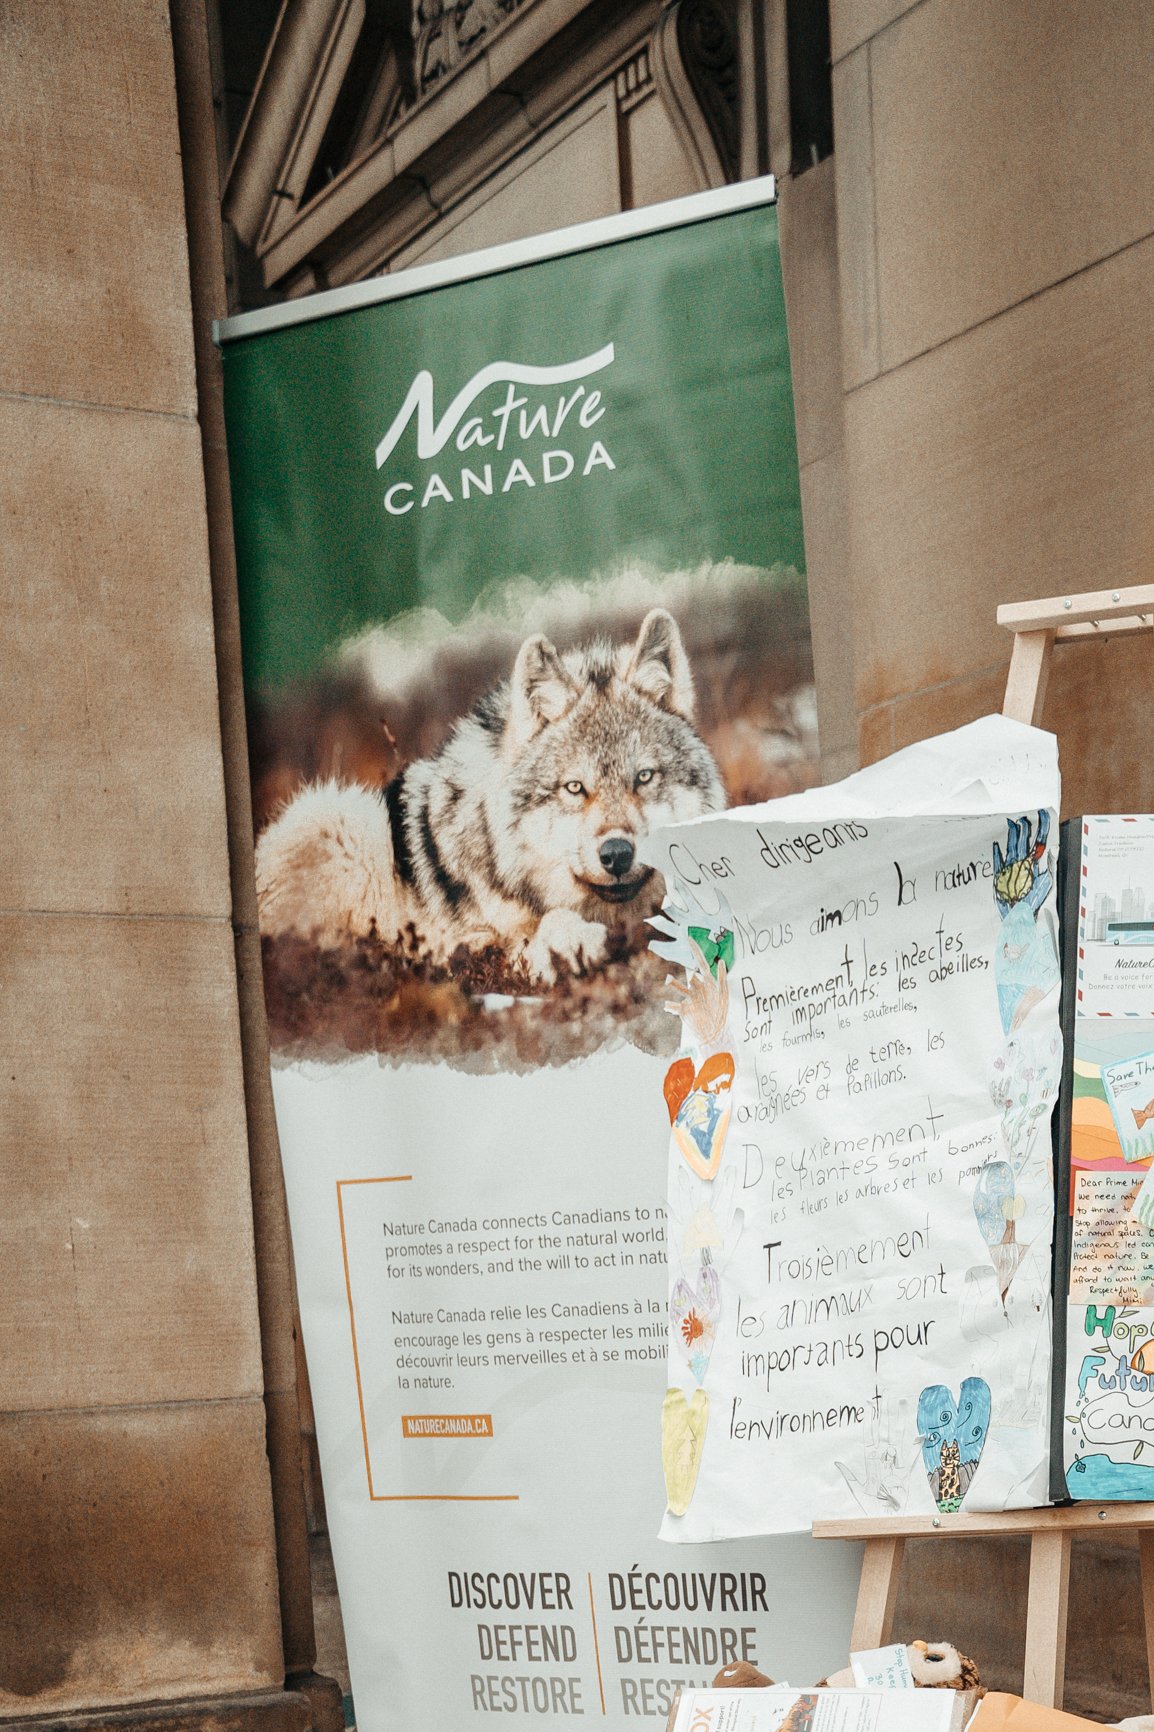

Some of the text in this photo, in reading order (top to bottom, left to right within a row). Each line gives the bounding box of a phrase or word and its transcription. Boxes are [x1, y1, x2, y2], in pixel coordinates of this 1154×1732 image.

[375, 342, 614, 469] Nature
[384, 442, 616, 514] CANADA
[669, 821, 869, 885] Cher dirigeants
[733, 913, 793, 959] Nous
[810, 891, 879, 936] aimons
[894, 862, 916, 906] la
[864, 938, 887, 980] les
[899, 968, 916, 992] les
[929, 953, 989, 983] abeilles,
[759, 1037, 773, 1054] les
[838, 1014, 851, 1031] les
[755, 1057, 777, 1099] les
[798, 1060, 831, 1086] vers
[846, 1054, 859, 1074] de
[927, 1029, 945, 1052] les
[1107, 1068, 1135, 1085] Save
[816, 1083, 831, 1100] et
[771, 1181, 793, 1202] les
[771, 1207, 786, 1224] les
[800, 1196, 828, 1219] fleurs
[836, 1188, 848, 1206] les
[928, 1168, 942, 1185] les
[1081, 1178, 1127, 1187] Dear Prime
[383, 1222, 425, 1236] Nature
[428, 1219, 478, 1234] Canada
[482, 1215, 547, 1231] connects
[552, 1207, 630, 1226] Canadians
[635, 1207, 650, 1221] to
[386, 1244, 442, 1260] promotes
[447, 1244, 454, 1254] a
[458, 1238, 509, 1256] respect
[514, 1236, 534, 1250] for
[538, 1235, 561, 1249] the
[566, 1231, 617, 1247] natural
[387, 1264, 405, 1278] for
[409, 1263, 422, 1277] its
[426, 1261, 483, 1277] wonders,
[487, 1258, 514, 1273] and
[519, 1257, 542, 1271] the
[546, 1255, 570, 1270] will
[574, 1255, 589, 1268] to
[594, 1253, 616, 1267] act
[621, 1250, 634, 1265] in
[392, 1311, 433, 1325] Nature
[437, 1308, 486, 1323] Canada
[490, 1305, 521, 1320] relie
[526, 1304, 547, 1318] les
[551, 1301, 629, 1317] Canadiens
[634, 1299, 642, 1314] à
[647, 1299, 660, 1313] la
[736, 1263, 947, 1338] les animaux sont
[394, 1334, 459, 1350] encourage
[463, 1332, 482, 1346] les
[487, 1331, 521, 1348] gens
[526, 1328, 535, 1343] à
[539, 1326, 607, 1343] respecter
[612, 1325, 633, 1339] les
[742, 1319, 935, 1392] importants pour
[396, 1354, 453, 1369] découvrir
[457, 1352, 489, 1367] leurs
[493, 1348, 567, 1366] merveilles
[572, 1347, 586, 1362] et
[590, 1346, 598, 1361] à
[603, 1349, 619, 1360] se
[398, 1375, 455, 1389] la nature.
[407, 1418, 489, 1434] NATURECANADA.CA
[448, 1571, 573, 1610] DISCOVER
[608, 1564, 769, 1612] DÉCOUVRIR
[477, 1624, 577, 1662] DEFEND
[614, 1616, 758, 1666] DÉFENDRE
[470, 1674, 584, 1714] RESTORE
